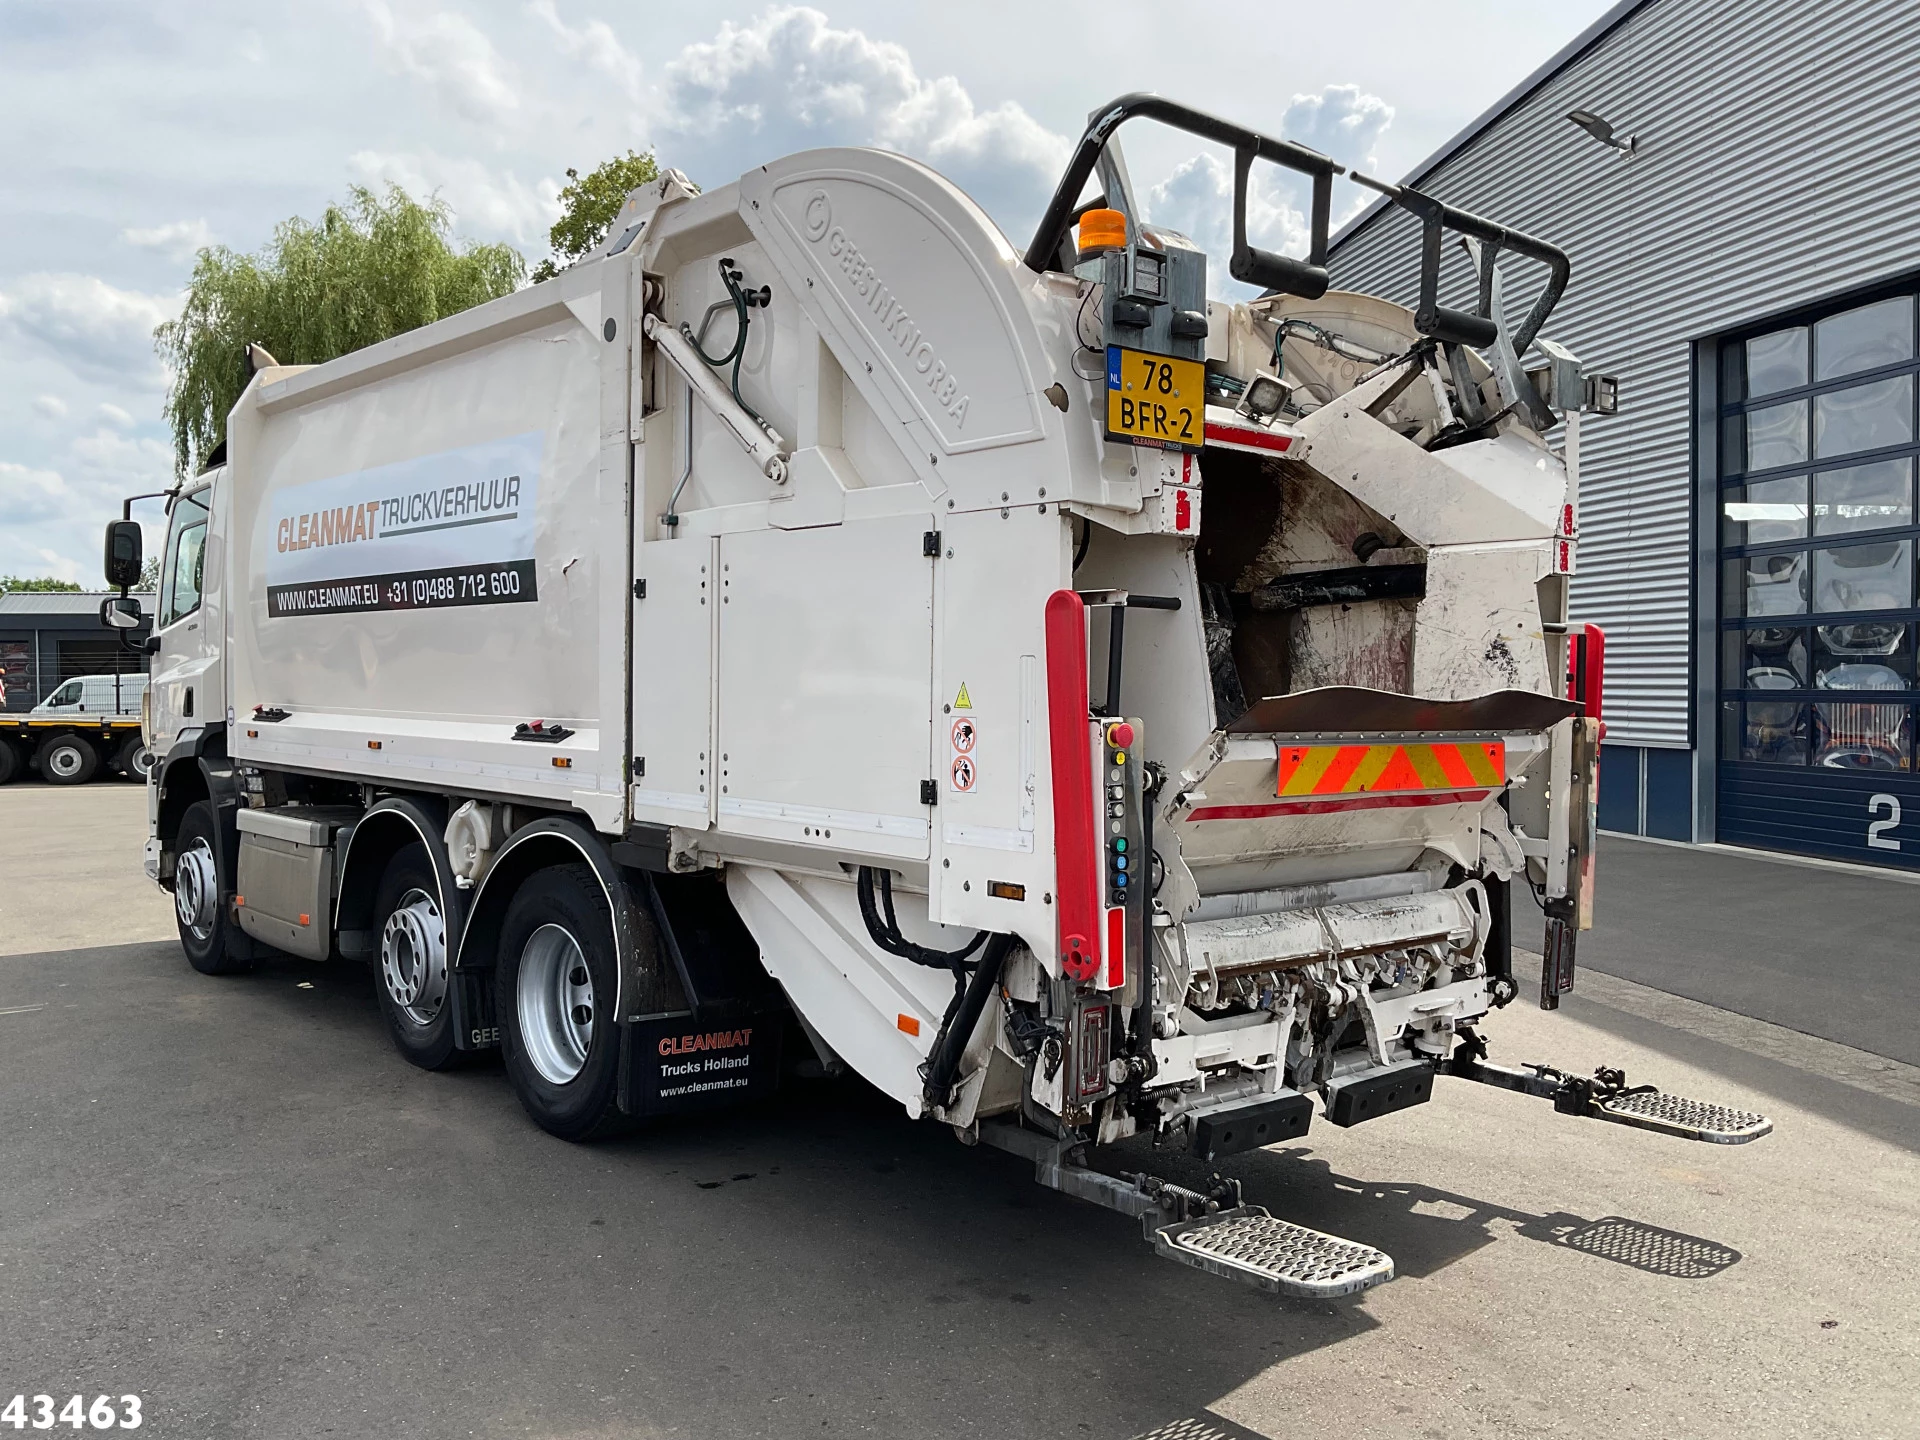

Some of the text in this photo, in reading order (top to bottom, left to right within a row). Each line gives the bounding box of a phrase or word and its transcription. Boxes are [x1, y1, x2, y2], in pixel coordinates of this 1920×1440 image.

[1110, 373, 1120, 384] NL
[1143, 360, 1173, 394] 78
[1121, 397, 1193, 439] BFR-2
[1133, 437, 1165, 448] CLEANMAT
[277, 475, 521, 554] CLEANMAT TRUCKVERHUUR
[277, 570, 520, 611] WWW.CLEANMAT.EU +31 (0)488 712 600
[1868, 794, 1900, 850] 2
[658, 1028, 753, 1056] CLEANMAT
[661, 1055, 749, 1077] Trucks Holland
[660, 1077, 749, 1098] www.cleanmat.eu
